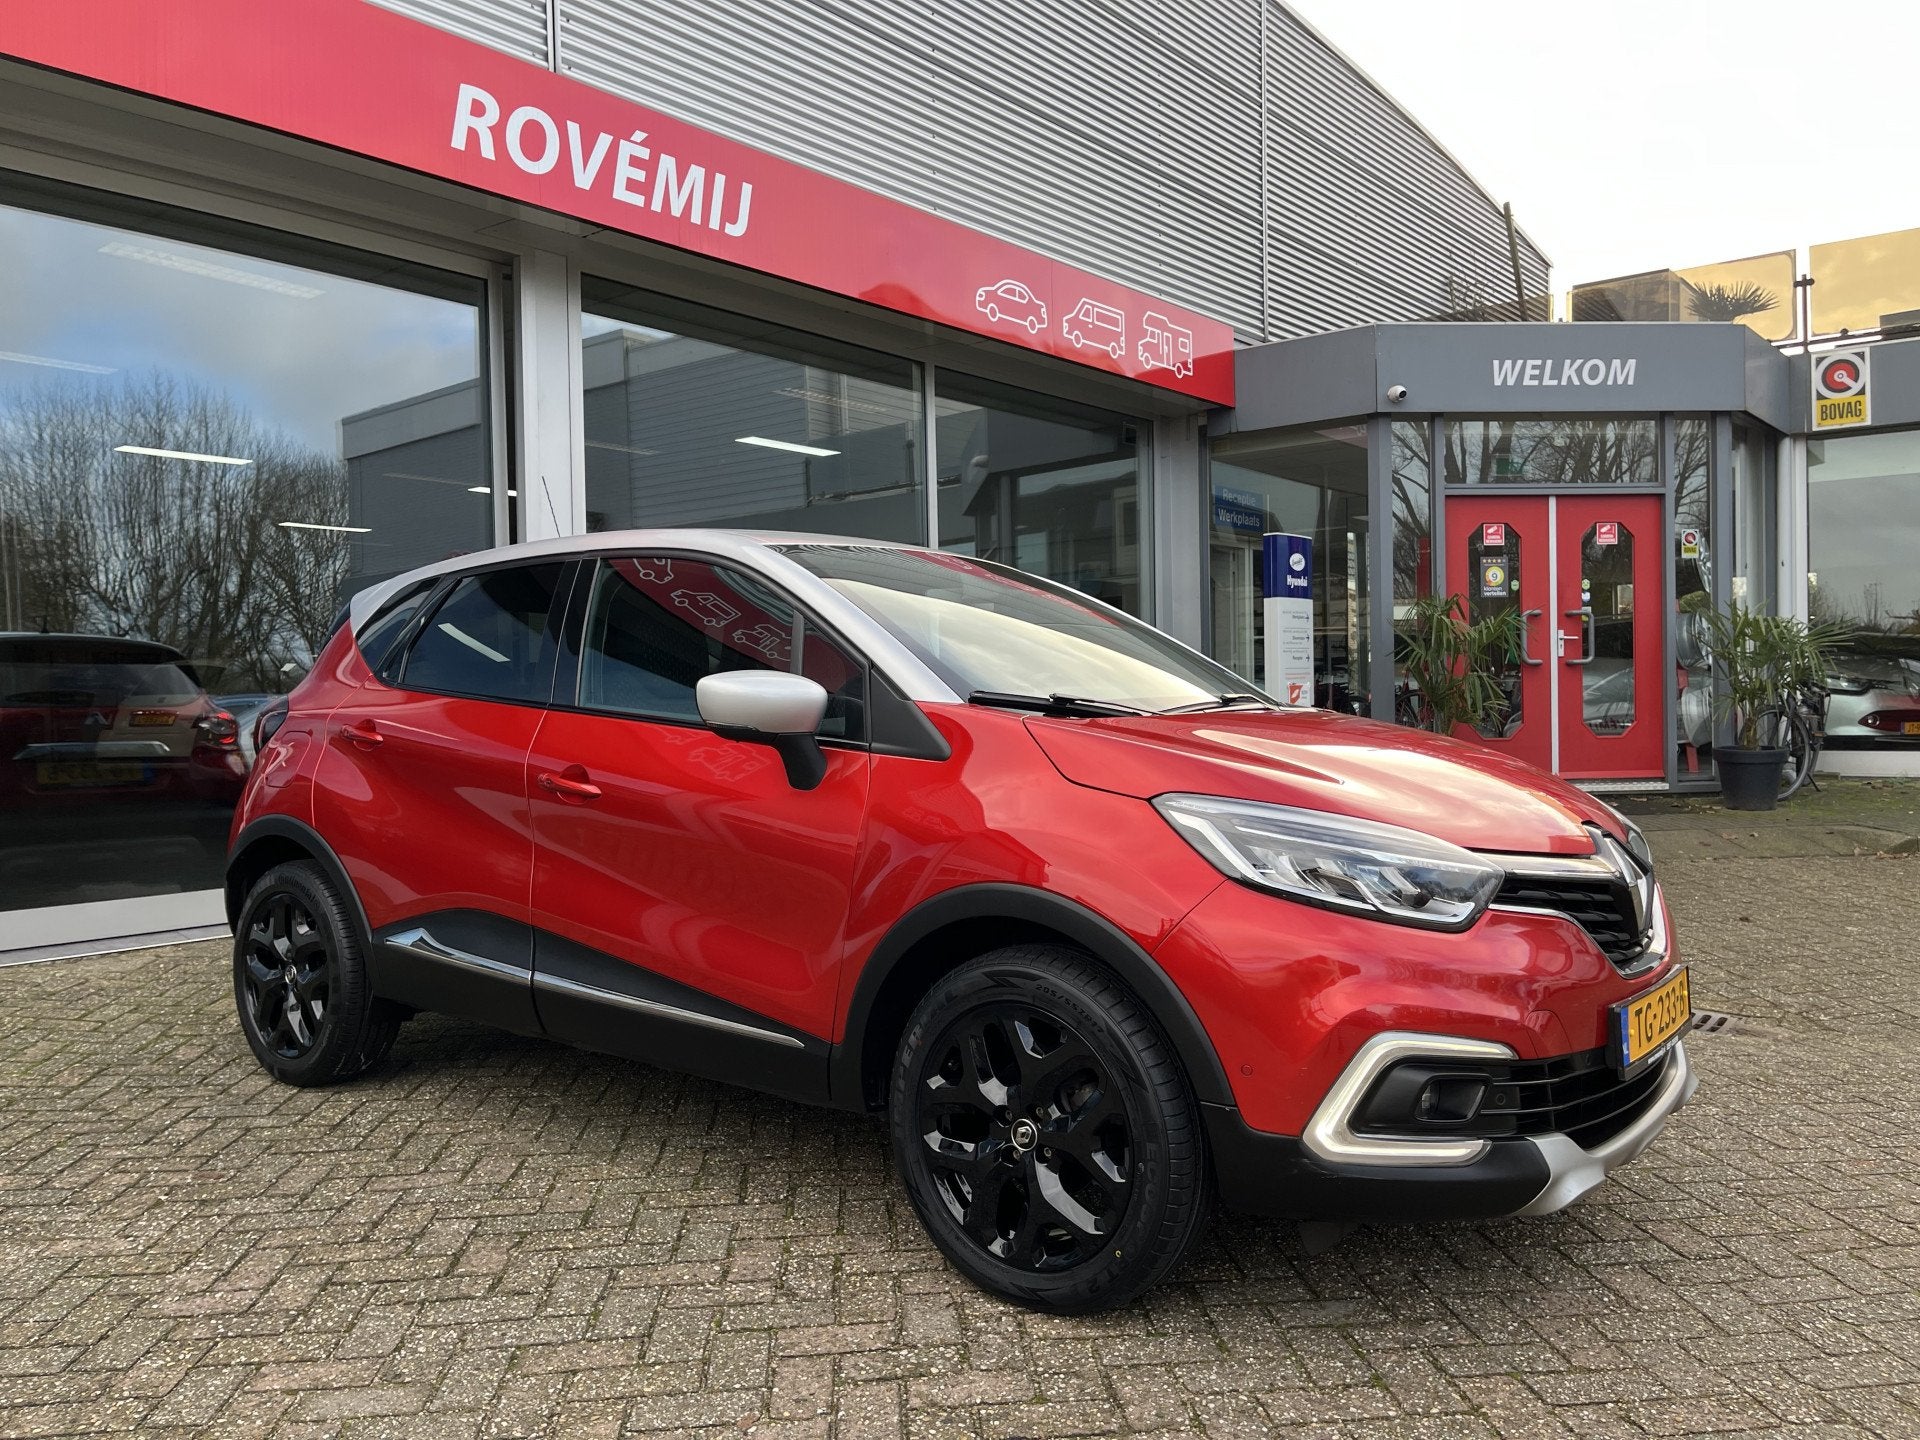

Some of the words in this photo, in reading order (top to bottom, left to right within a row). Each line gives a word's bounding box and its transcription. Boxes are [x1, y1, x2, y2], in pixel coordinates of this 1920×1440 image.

[450, 83, 752, 237] ROVÉMIJ
[1492, 358, 1637, 387] WELKOM
[1820, 400, 1862, 421] BOVAG
[1218, 508, 1260, 527] Werkplaats
[1287, 574, 1308, 588] Hyundai
[1634, 980, 1685, 1048] TG-233-B
